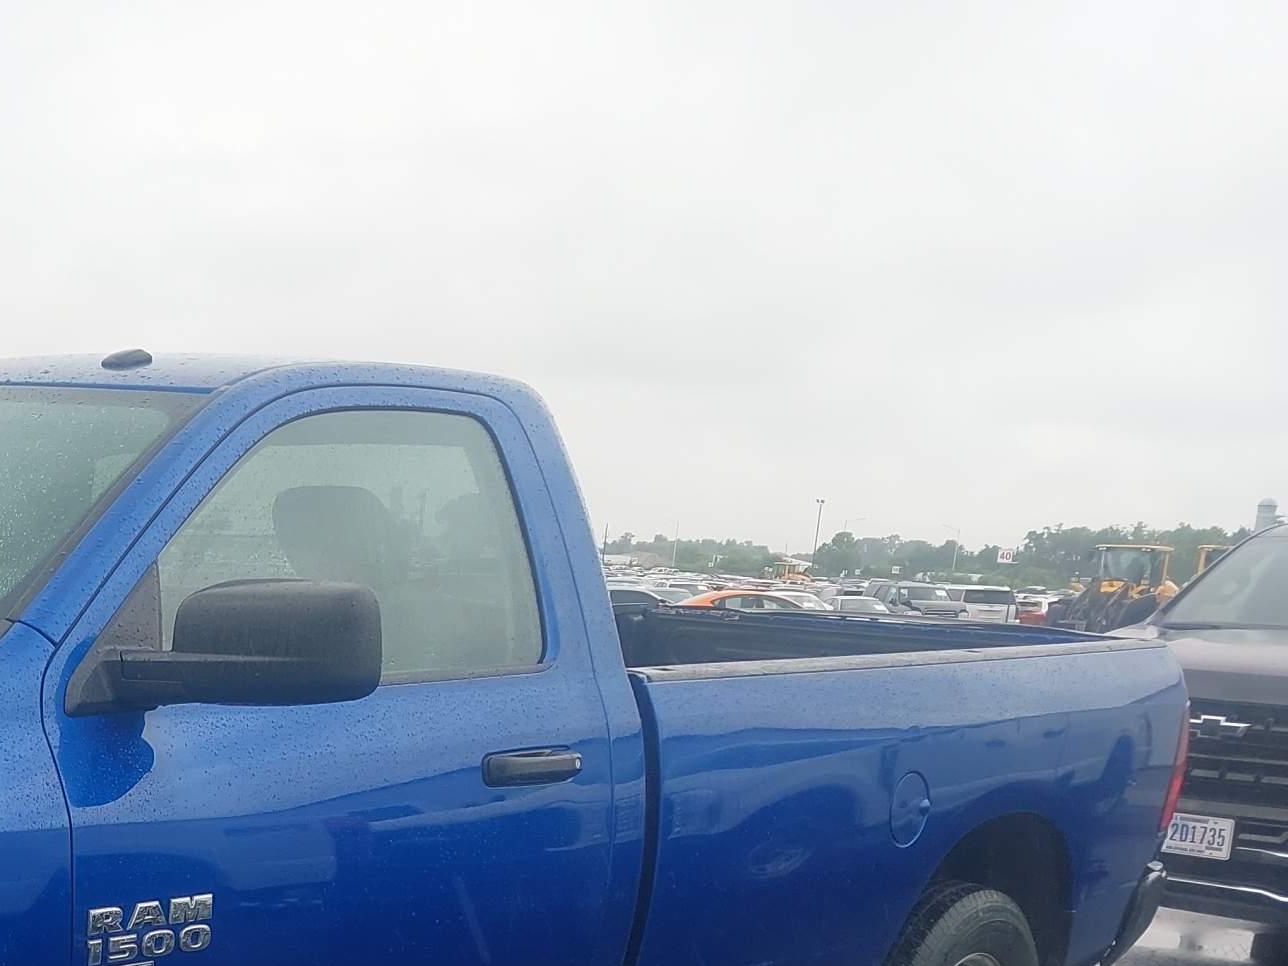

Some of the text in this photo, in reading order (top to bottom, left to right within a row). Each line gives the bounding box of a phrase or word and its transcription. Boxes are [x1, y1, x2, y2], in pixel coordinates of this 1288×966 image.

[1000, 551, 1011, 561] 40
[88, 894, 213, 935] RAM
[87, 924, 212, 966] 1500
